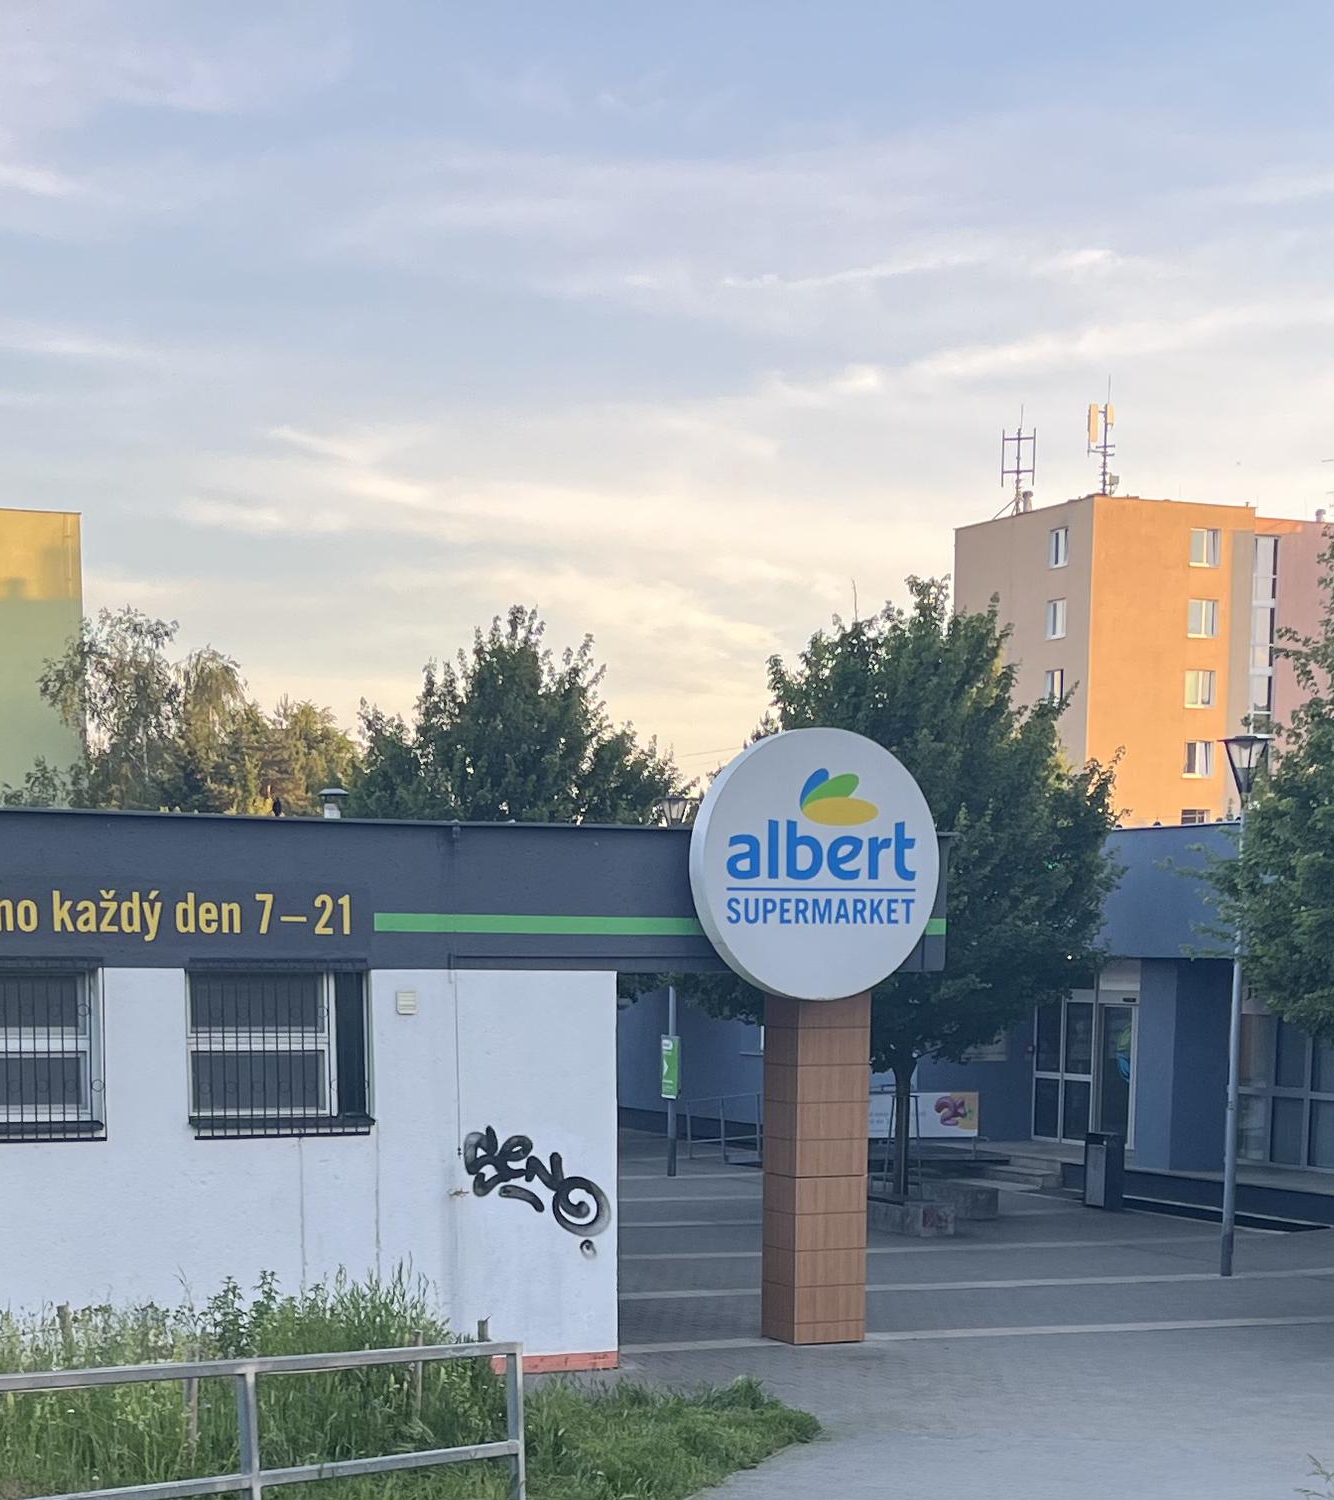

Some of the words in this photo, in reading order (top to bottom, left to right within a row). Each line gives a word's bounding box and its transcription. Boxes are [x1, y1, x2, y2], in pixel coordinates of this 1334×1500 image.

[726, 819, 917, 882] albert
[53, 889, 163, 942] každý
[175, 892, 242, 935] den
[726, 897, 915, 925] SUPERMARKET
